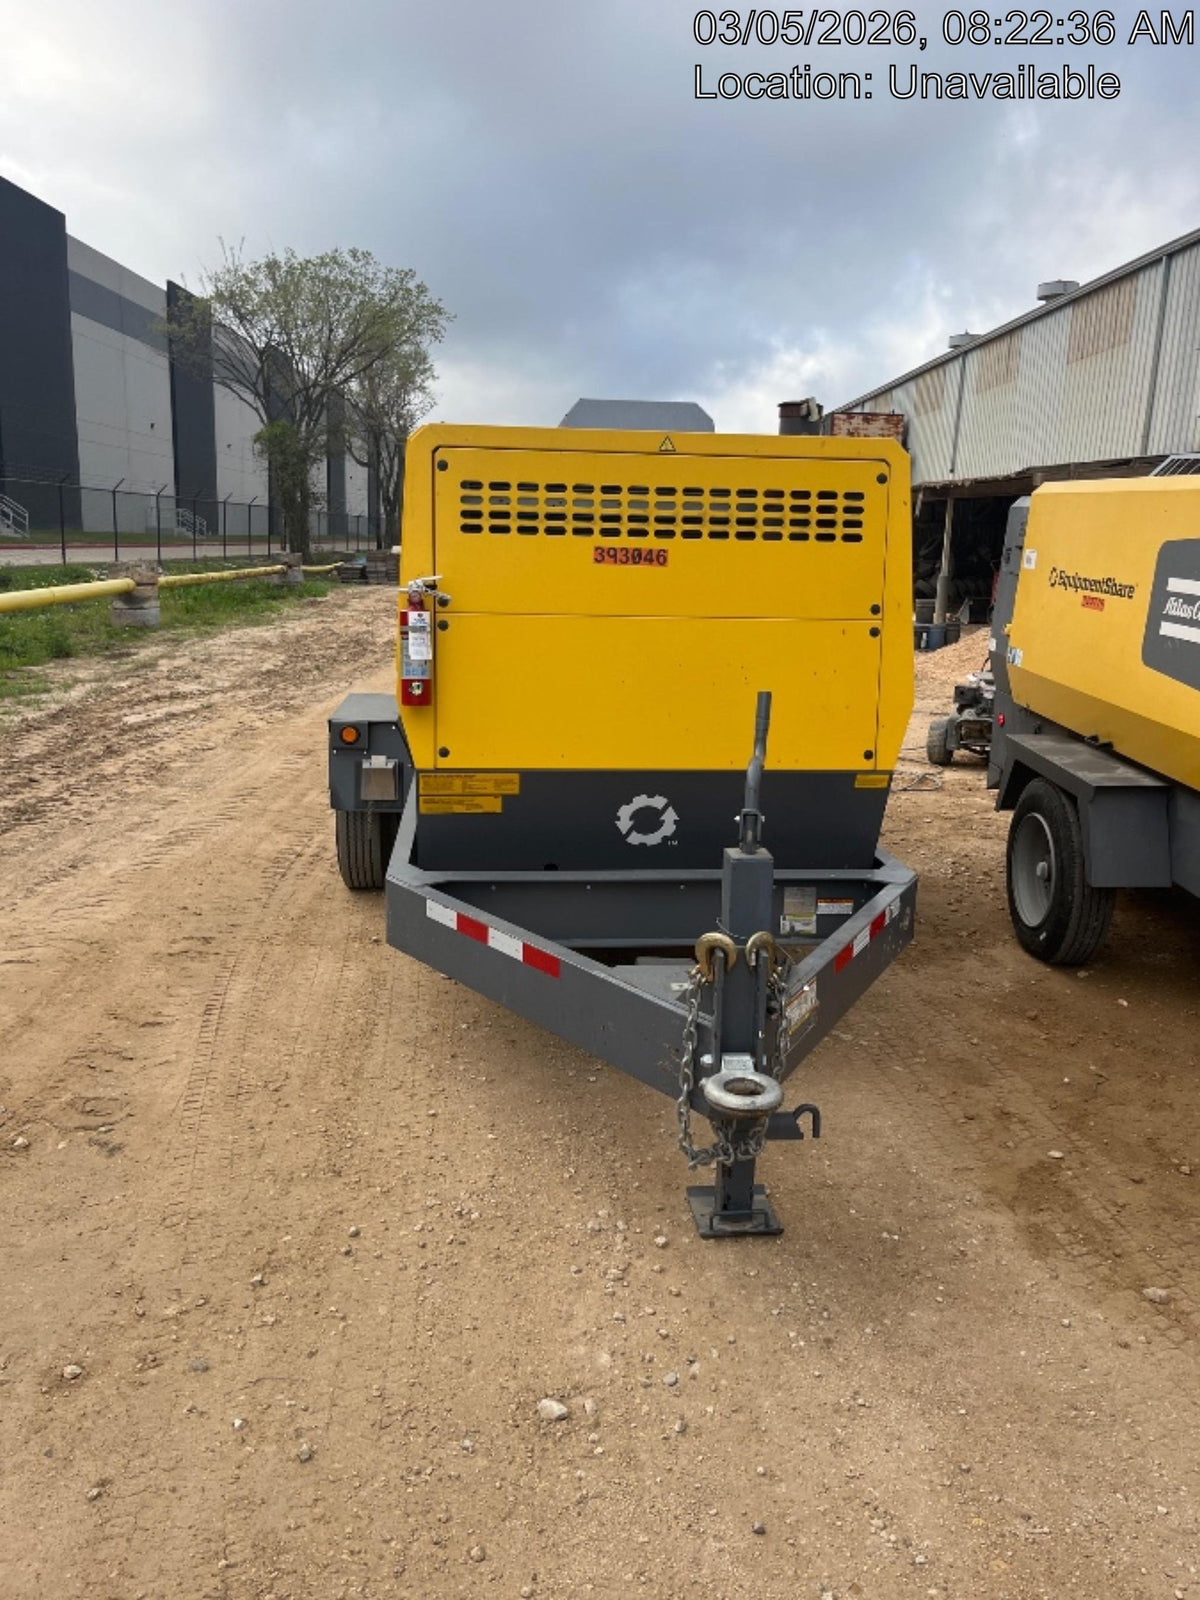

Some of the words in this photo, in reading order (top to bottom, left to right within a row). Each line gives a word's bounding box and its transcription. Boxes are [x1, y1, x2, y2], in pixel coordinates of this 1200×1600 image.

[594, 546, 668, 566] 393046
[1057, 570, 1136, 599] EquipmentShare
[1162, 597, 1192, 619] Atlas
